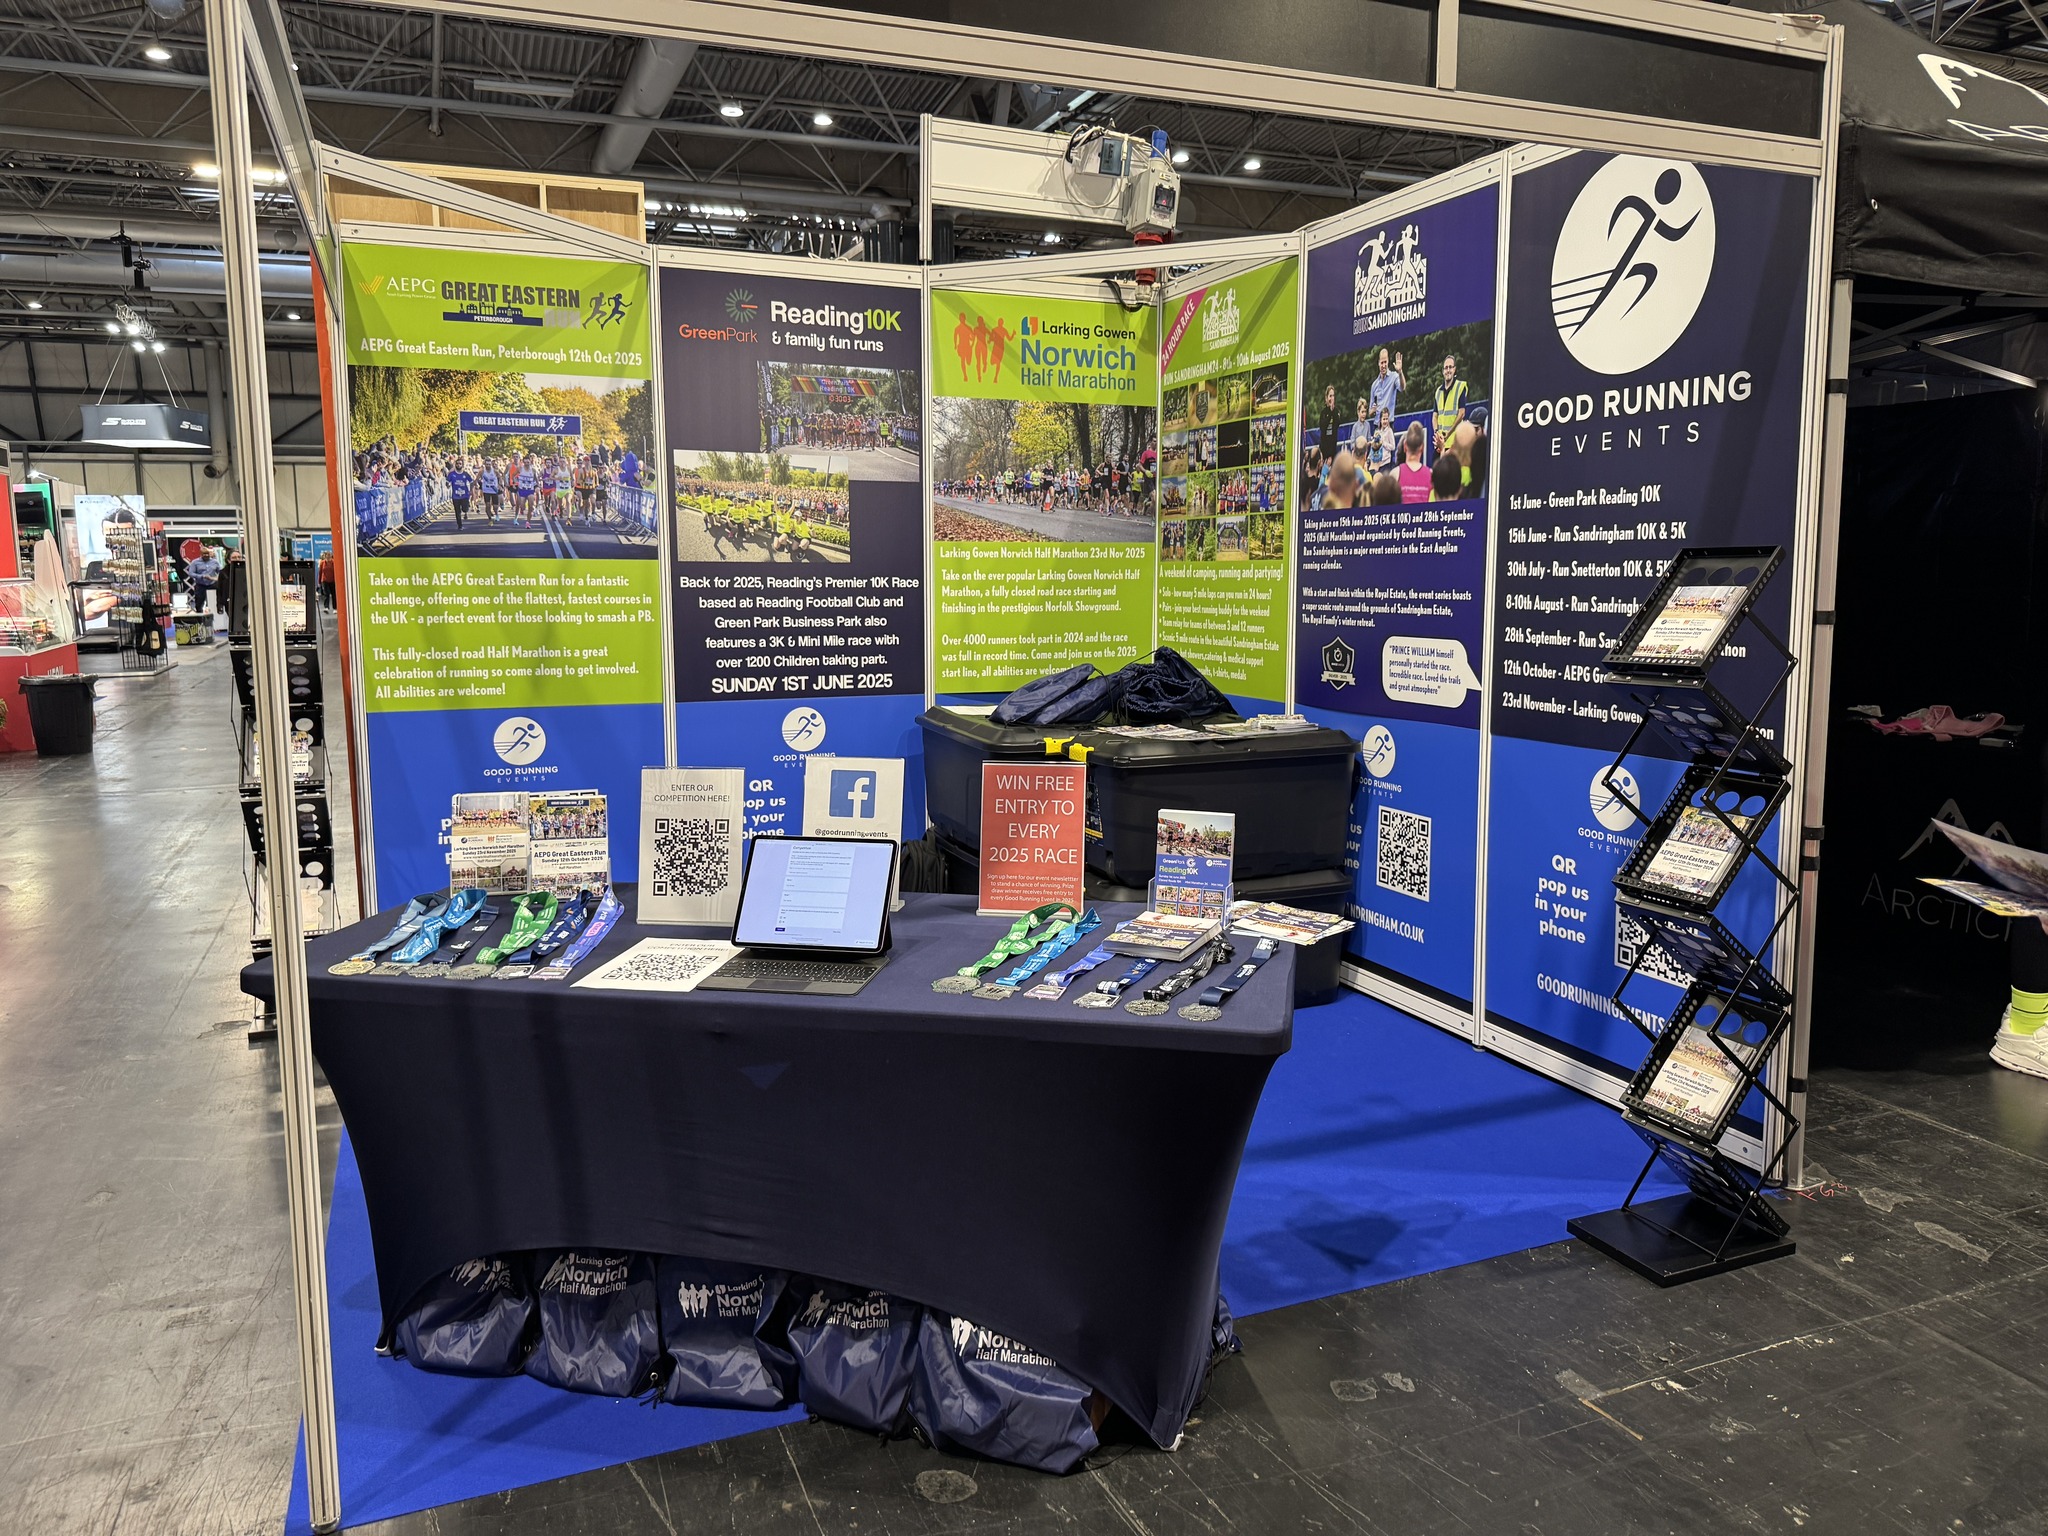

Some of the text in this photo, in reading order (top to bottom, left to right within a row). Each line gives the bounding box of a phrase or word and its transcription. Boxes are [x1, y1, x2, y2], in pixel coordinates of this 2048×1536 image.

[387, 277, 436, 293] AEPG
[441, 280, 580, 309] GREAT EASTERN
[474, 315, 513, 323] PETERBOROUGH
[544, 309, 581, 329] RUN
[771, 301, 902, 335] Reading10K
[1167, 325, 1183, 352] HOUR
[1180, 298, 1196, 325] RACE
[679, 324, 758, 343] GreenPark
[1043, 321, 1135, 340] Larking Gowen
[772, 331, 884, 352] & family fun runs
[361, 338, 642, 366] AEPG Great Eastern Run, Peterborough 12th Oct 2025
[1021, 339, 1136, 371] Norwich
[1174, 360, 1219, 382] SANDRINGHAM24
[1222, 357, 1232, 371] 8th
[1236, 352, 1249, 366] 10th
[1250, 347, 1271, 365] August
[1272, 341, 1290, 359] 2025
[1021, 368, 1136, 391] Half Marathon
[1518, 371, 1751, 428] GOOD RUNNING
[473, 416, 545, 427] GREAT EASTERN RUN
[1552, 422, 1699, 456] EVENTS
[1510, 495, 1521, 510] 1st
[1523, 494, 1542, 509] June
[1549, 492, 1575, 508] Green
[1577, 489, 1597, 506] Park
[1599, 487, 1638, 506] Reading
[1641, 485, 1661, 502] 10K
[1509, 528, 1526, 543] 15th
[1528, 527, 1547, 543] June
[1554, 526, 1571, 542] Run
[1573, 524, 1634, 543] Sandringham
[1637, 523, 1656, 540] 10K
[1659, 522, 1667, 540] &
[1671, 522, 1686, 539] 5K
[940, 547, 1145, 560] Larking Gowen Norwich Half Marathon 23rd Nov 2025
[1160, 564, 1283, 581] A weekend of camping, running and partying!
[1507, 561, 1527, 576] 30th
[1528, 561, 1546, 579] July
[1552, 561, 1569, 576] Run
[1571, 561, 1620, 577] Snetterton
[1623, 561, 1643, 577] 10K
[1645, 561, 1653, 577] &
[1506, 594, 1532, 610] 8-10th
[1534, 595, 1564, 614] August
[1571, 597, 1589, 612] Run
[1505, 627, 1524, 643] 28th
[1526, 628, 1570, 646] September
[1578, 630, 1597, 648] Run
[1389, 660, 1412, 669] personally
[1413, 661, 1430, 669] started
[1504, 660, 1521, 676] 12th
[1523, 661, 1557, 679] October
[1564, 665, 1590, 682] AEPG
[376, 686, 391, 698] All
[393, 685, 436, 698] abilities
[457, 683, 506, 696] welcome!
[712, 674, 893, 693] SUNDAY 1ST JUNE 2025
[1502, 692, 1522, 708] 23rd
[1524, 694, 1566, 714] November
[1573, 700, 1608, 721] Larking
[484, 766, 558, 776] GOOD RUNNING
[749, 780, 774, 792] QR
[996, 775, 1074, 791] WIN FREE
[743, 797, 786, 810] op us
[995, 799, 1074, 815] ENTRY TO
[752, 813, 785, 827] your
[1008, 824, 1060, 839] EVERY
[989, 848, 1077, 864] 2025 RACE
[1552, 855, 1577, 875] QR
[1538, 877, 1589, 901] pop us
[1535, 893, 1587, 922] in your
[1540, 919, 1586, 943] phone
[575, 1255, 602, 1267] Larking
[562, 1265, 628, 1284] Norwich
[560, 1281, 627, 1296] Half Marathon
[727, 1279, 758, 1291] Larking
[718, 1307, 739, 1317] Half
[826, 1312, 889, 1329] alf Marathon
[976, 1348, 999, 1361] Half
